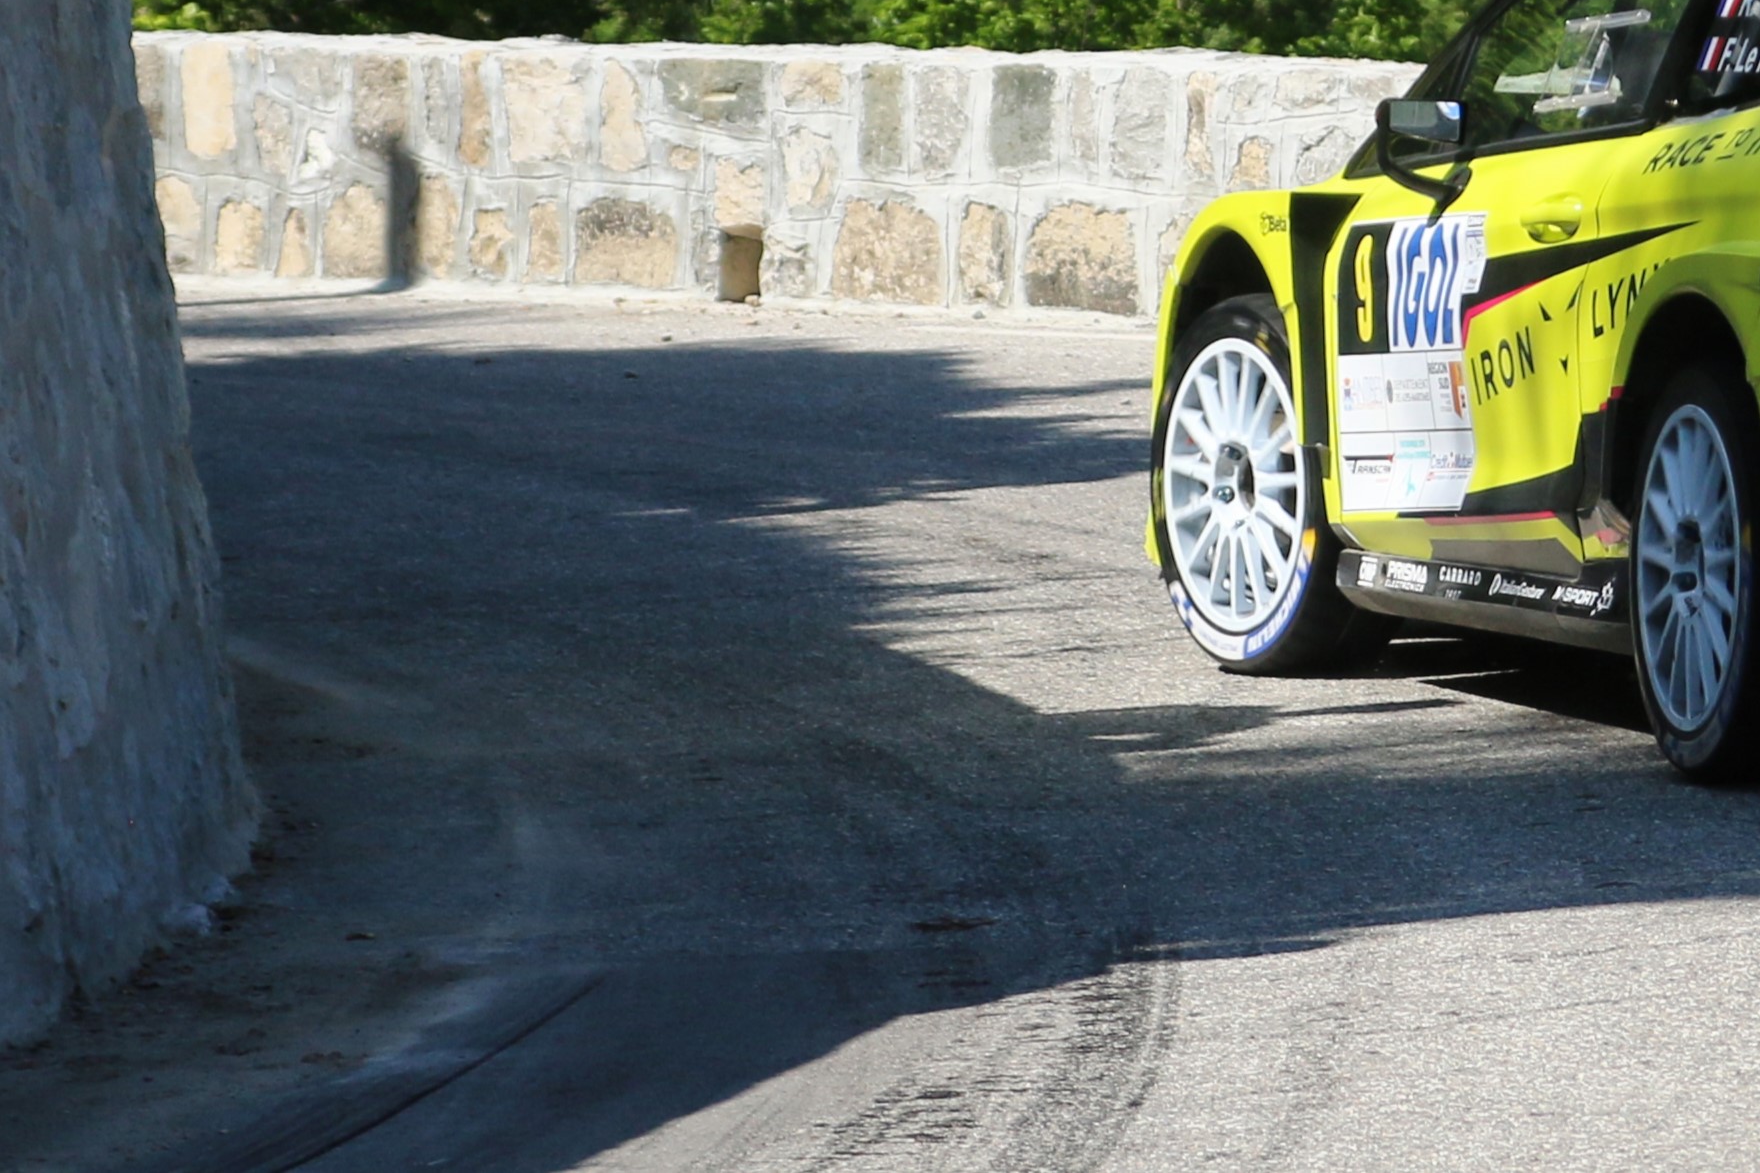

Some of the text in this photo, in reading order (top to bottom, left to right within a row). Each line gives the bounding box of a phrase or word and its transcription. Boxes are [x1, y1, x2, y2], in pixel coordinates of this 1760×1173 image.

[1734, 38, 1758, 73] Le
[1642, 132, 1726, 174] RACE
[1354, 223, 1460, 348] 9 IGOL
[1470, 325, 1535, 405] IRON
[1591, 258, 1671, 339] LYN
[1387, 560, 1428, 584] PRISMA
[1439, 566, 1481, 586] CARRARO
